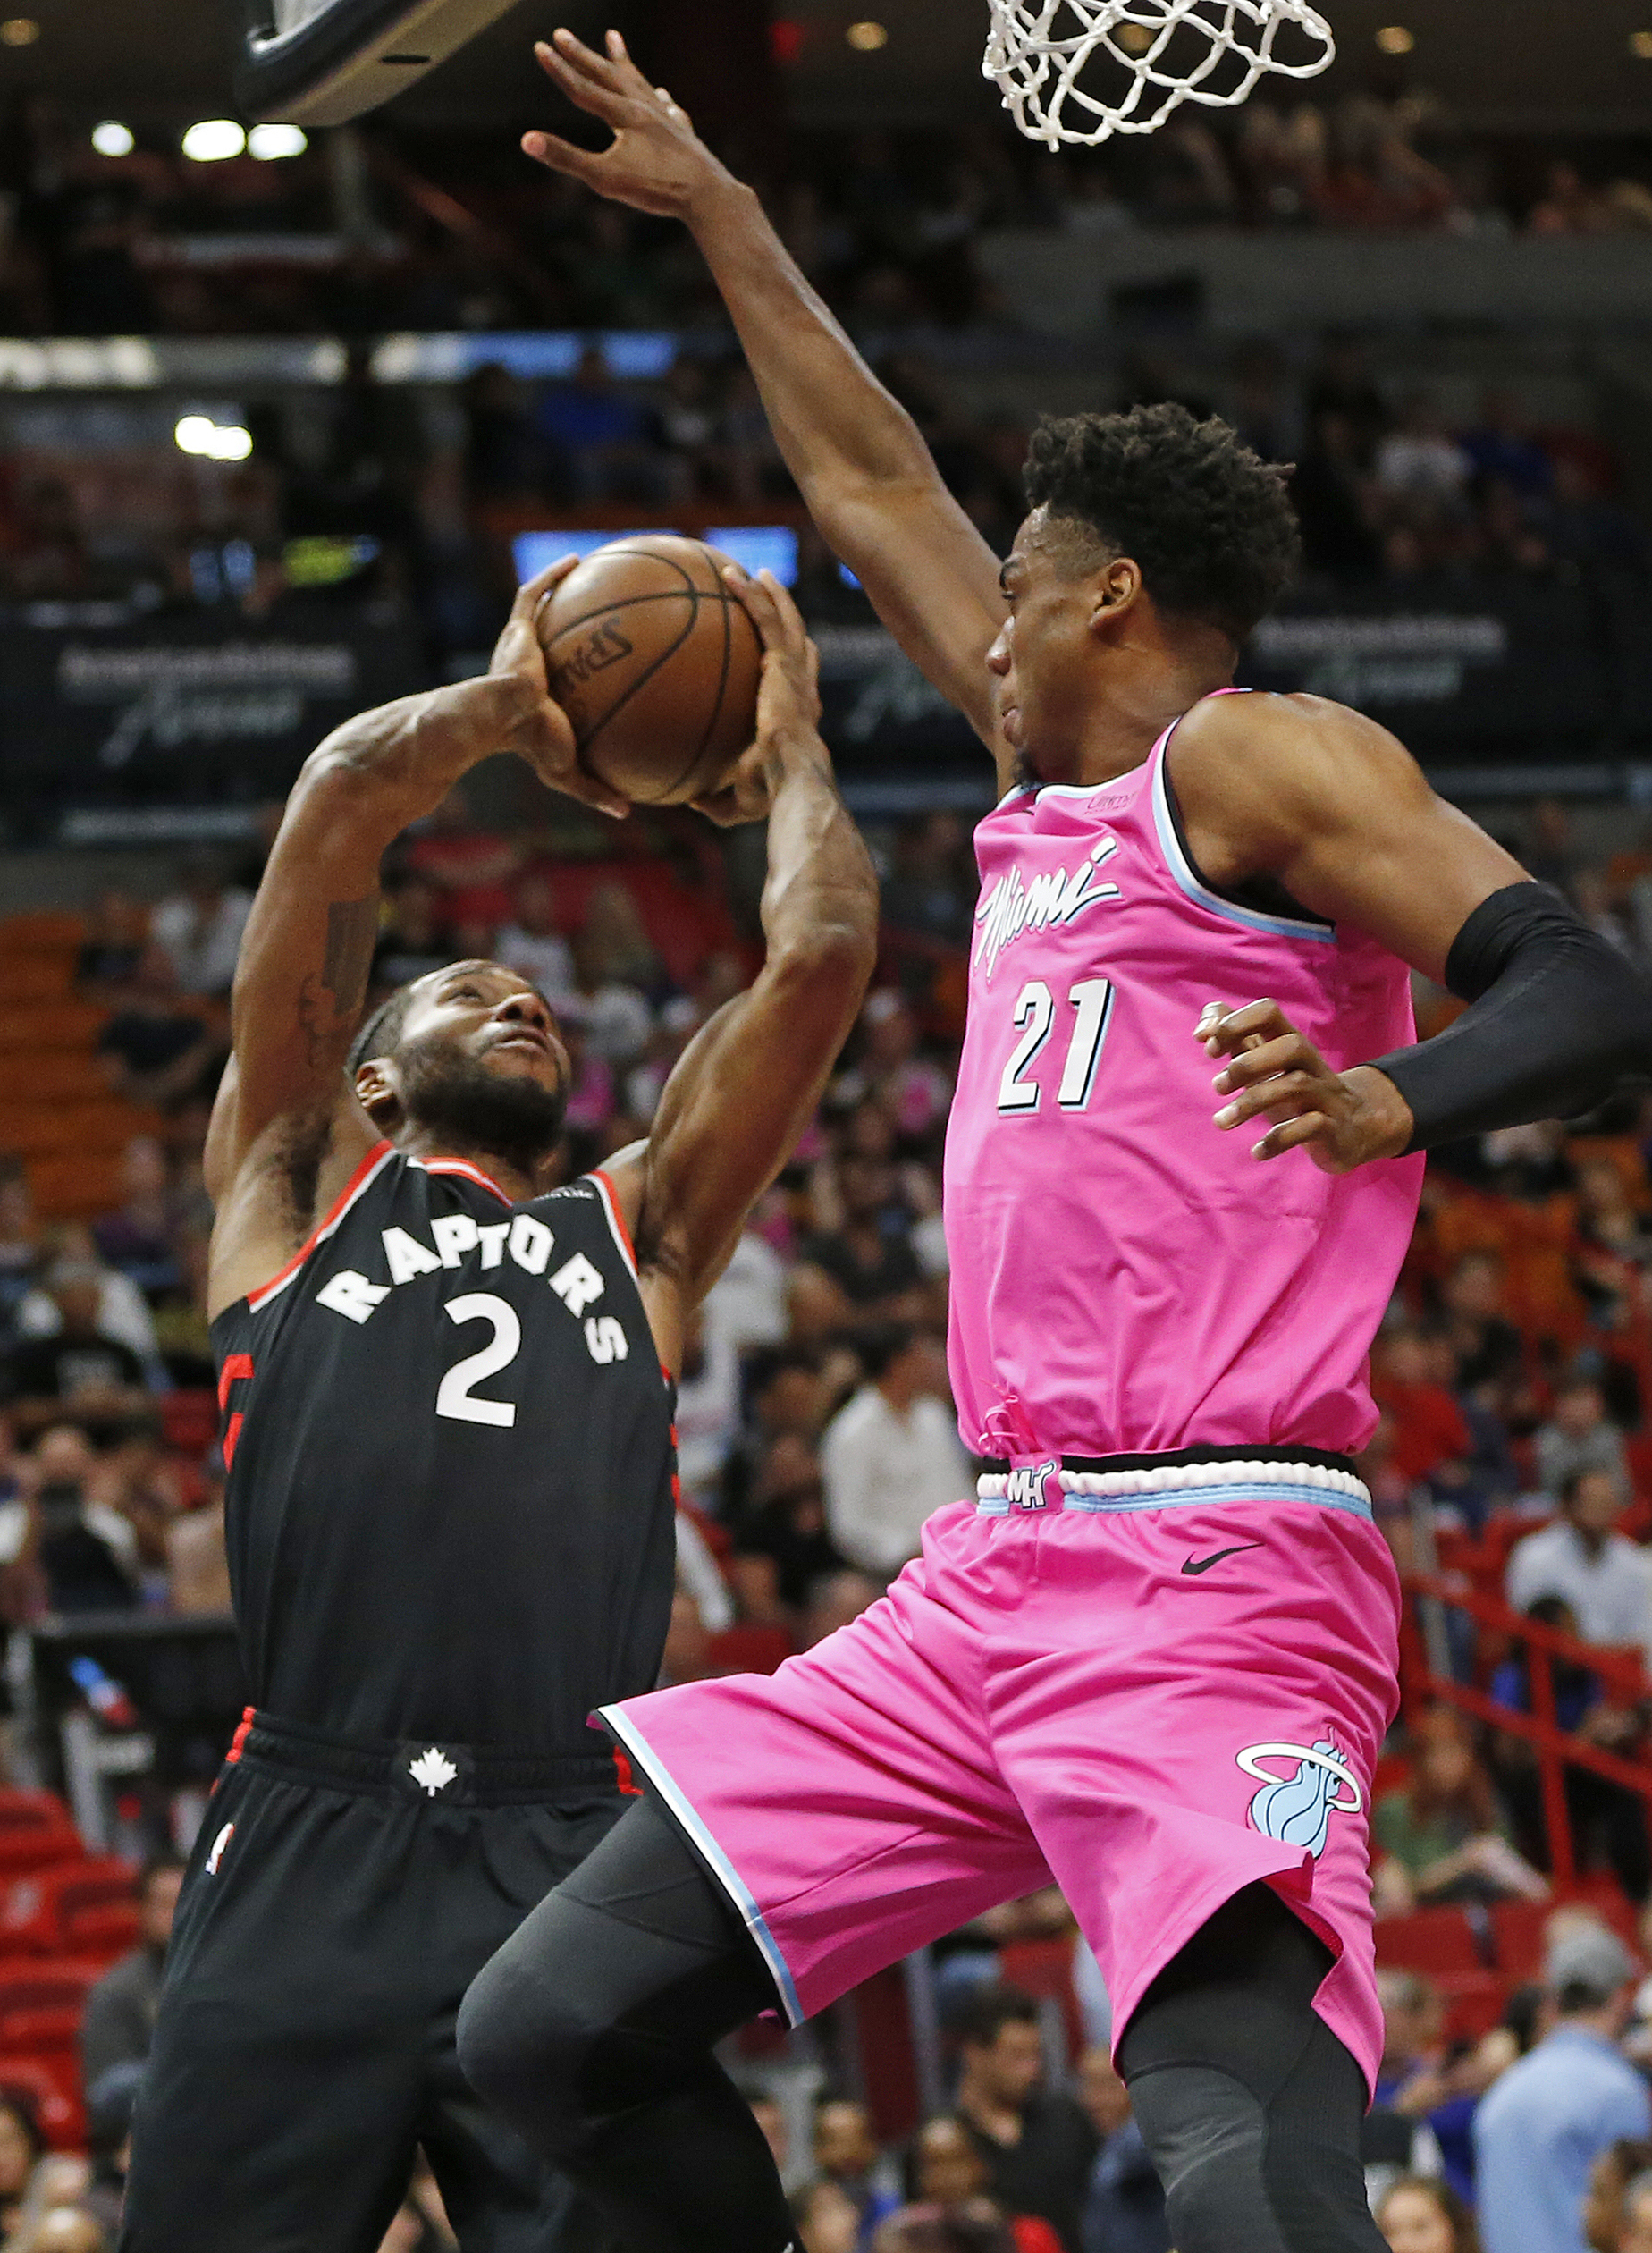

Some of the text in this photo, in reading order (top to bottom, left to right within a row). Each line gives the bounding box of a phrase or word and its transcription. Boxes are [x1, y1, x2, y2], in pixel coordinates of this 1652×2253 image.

[997, 978, 1115, 1115] 21
[316, 1213, 629, 1365] RAPTORS
[435, 1292, 522, 1429] 2
